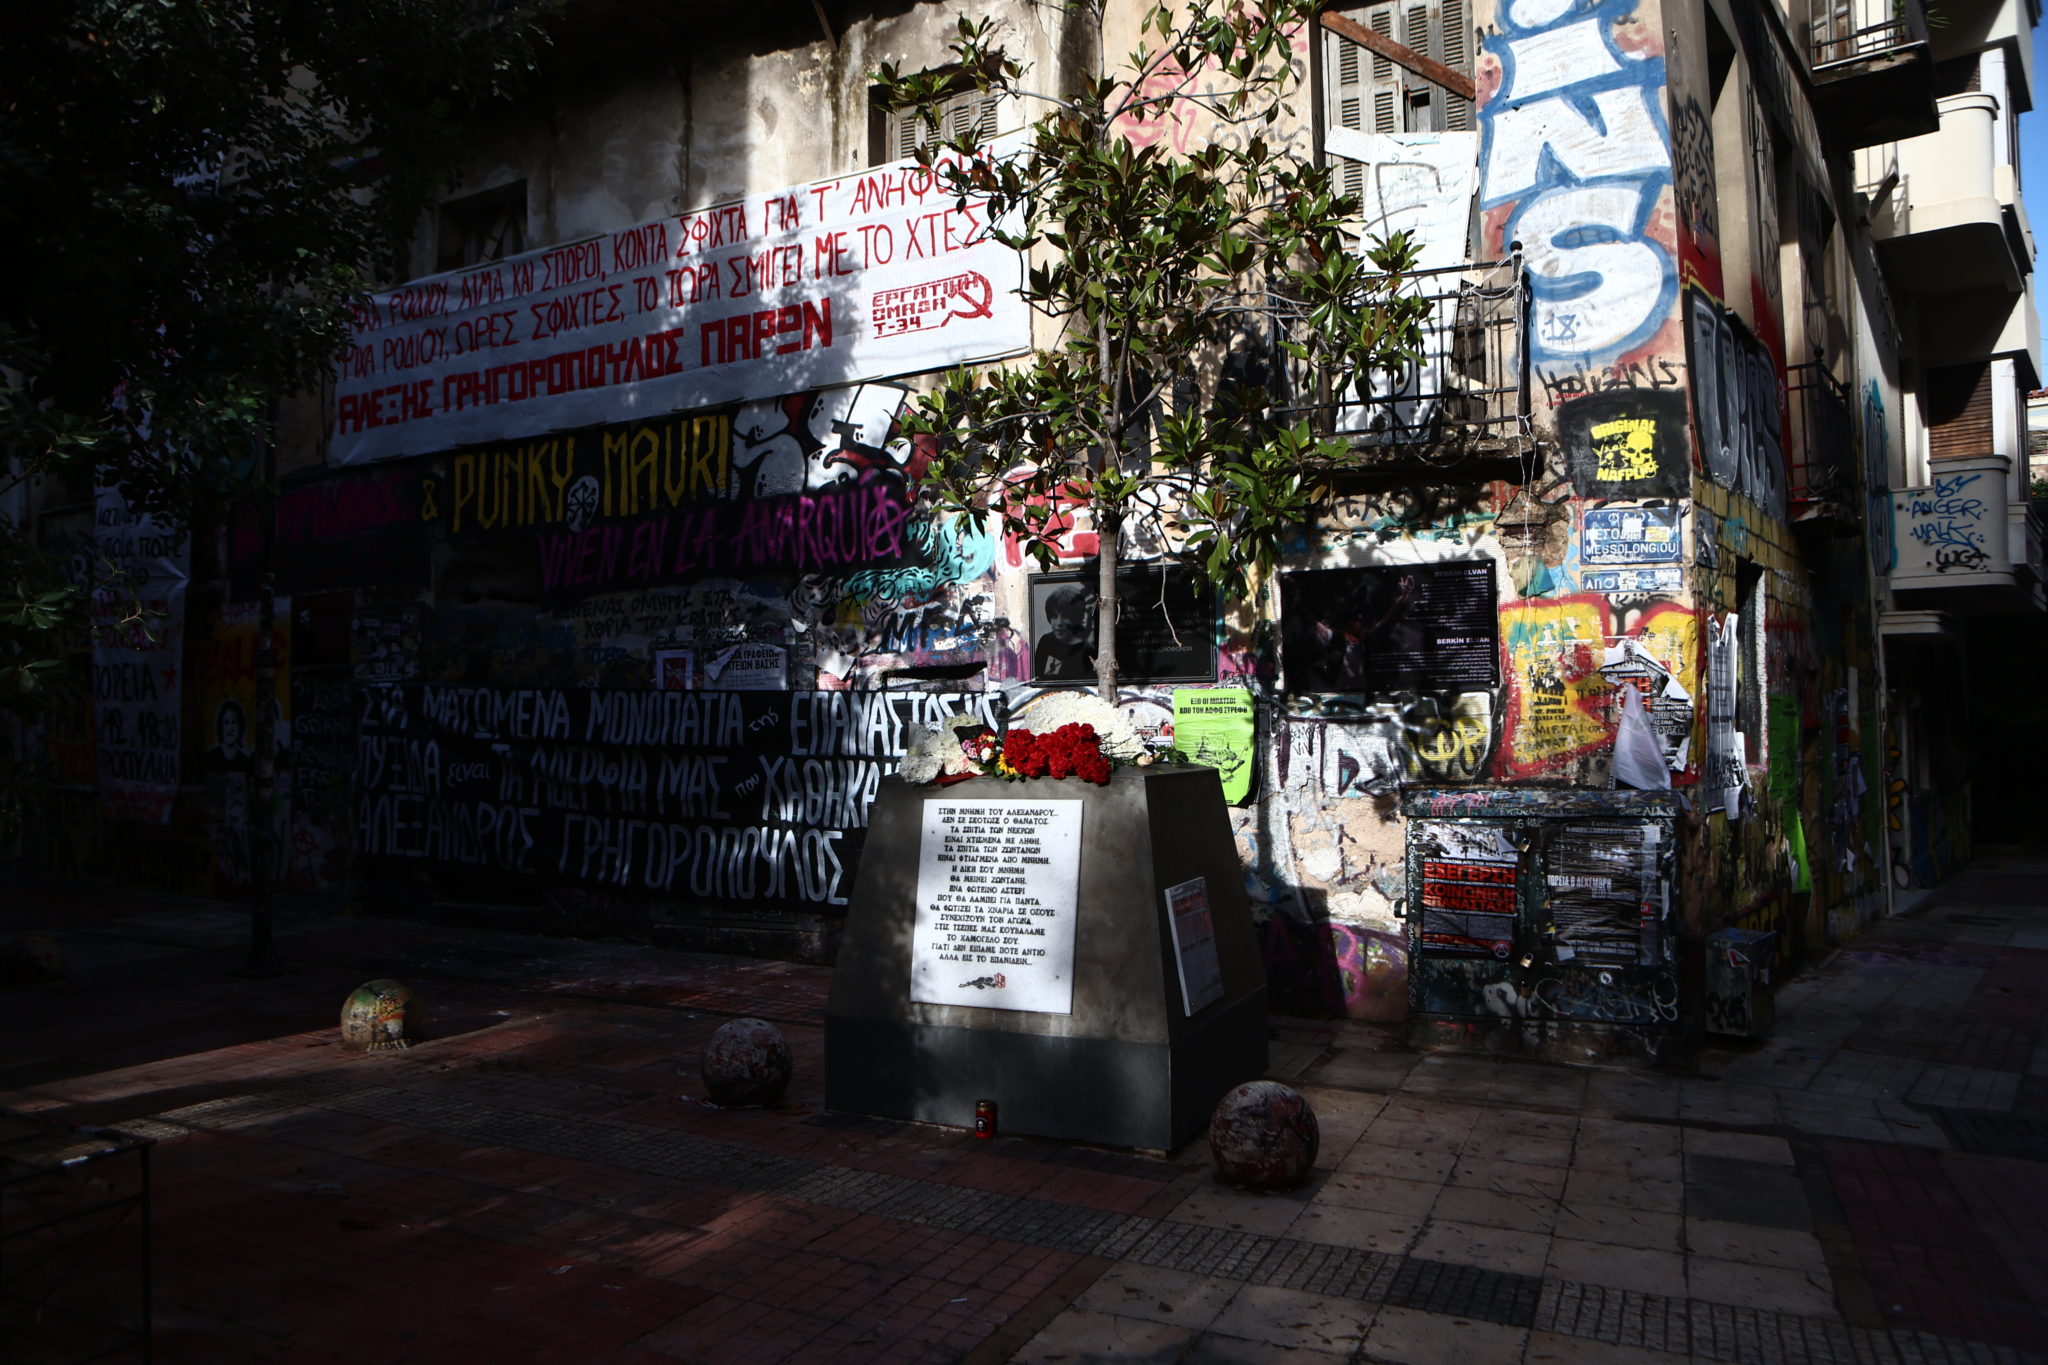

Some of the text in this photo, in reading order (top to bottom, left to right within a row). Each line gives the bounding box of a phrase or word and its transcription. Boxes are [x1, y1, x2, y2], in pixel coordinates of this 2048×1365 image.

[389, 282, 449, 328] ΡΟΔΙΟΥ,
[460, 271, 504, 309] ΑΙΜΑ
[513, 261, 533, 296] ΚΑΙ
[542, 242, 606, 288] ΣΠΟΡΟΙ,
[614, 223, 668, 272] ΚΟΝΤΑ
[677, 205, 747, 258] ΣΦΙΧΤΑ
[764, 195, 799, 236] ΓΙΑ
[384, 326, 450, 374] ΡΟΔΙΟΥ,
[455, 310, 519, 355] ΩΡΕΣ
[532, 285, 626, 340] ΣΦΙΧΤΕΣ,
[634, 277, 658, 313] ΤΟ
[666, 262, 720, 309] ΤΩΡΑ
[727, 244, 803, 298] ΣΜΙΓΕΙ
[815, 232, 854, 280] ΜΕ
[857, 224, 893, 269] ΤΟ
[906, 202, 988, 259] ΧΤΕΣ
[873, 297, 946, 321] ΟΜΑΔΑ
[339, 297, 832, 435] ΑΛΕΞΗΣ ΓΡΗΓΟΡΟΠΟΥΛΟΣ ΠΑΡΩΝ
[1591, 419, 1657, 441] ORIGINAL
[452, 435, 576, 534] PUNKY
[602, 414, 731, 517] MAURI
[626, 516, 670, 582] EN
[1586, 543, 1676, 555] MESSOLONGIOU
[96, 660, 157, 703] ΟΡΕΙΑ
[1179, 707, 1192, 715] ΑΠΟ
[1223, 706, 1248, 714] ΣΤΡΕΦΗ
[585, 689, 745, 748] ΜΟΝΟΠΑΤΙΑ
[656, 752, 731, 821] ΜΑΣ
[758, 753, 901, 829] ΧΑΘΗΚΑ
[989, 808, 1003, 816] ΤΟΥ
[963, 826, 985, 834] ΣΠΙΤΙΑ
[989, 826, 1004, 834] ΤΩΝ
[966, 836, 1001, 844] ΧΤΙΣΜΕΝΑ
[1005, 837, 1015, 845] ΜΕ
[1019, 837, 1041, 845] ΛΗΘΗ.
[957, 845, 980, 853] ΣΠΙΤΙΑ
[1001, 846, 1041, 854] ΖΩΝΤΑΝΩΝ
[557, 812, 849, 905] ΓΡΗΓΟΡΟΠΟΥΛΟΣ
[938, 854, 1050, 865] ΕΙΝΑΙ ΦΤΙΑΓΜΕΝΑ ΑΠΟ ΜΝΗΜΗ.
[960, 865, 976, 873] ΔΙΚΗ
[964, 875, 987, 883] ΜΕΙΝΕΙ
[966, 886, 997, 894] ΦΩΤΕΙΝΟ
[1000, 887, 1025, 895] ΑΣΤΕΡΙ
[1423, 882, 1516, 900] ΚΟΙΝΩΝΙΚΗ
[1015, 897, 1041, 906] ΠΑΝΤΑ.
[943, 904, 971, 912] ΦΩΤΙΖΕΙ
[974, 905, 984, 913] ΤΑ
[988, 906, 1014, 915] ΧΝΑΡΙΑ
[1030, 908, 1055, 917] ΟΣΟΥΣ
[941, 913, 985, 922] ΣΥΝΕΧΙΖΟΥΝ
[1007, 917, 1034, 925] ΑΓΩΝΑ.
[981, 925, 996, 933] ΜΑΣ
[999, 926, 1045, 936] ΚΟΥΒΑΛΑΜΕ
[960, 934, 1000, 943] ΧΑΜΟΓΕΛΟ
[970, 945, 996, 953] ΕΙΠΑΜΕ
[999, 947, 1018, 955] ΠΟΤΕ
[1022, 948, 1045, 956] ΑΝΤΙΟ
